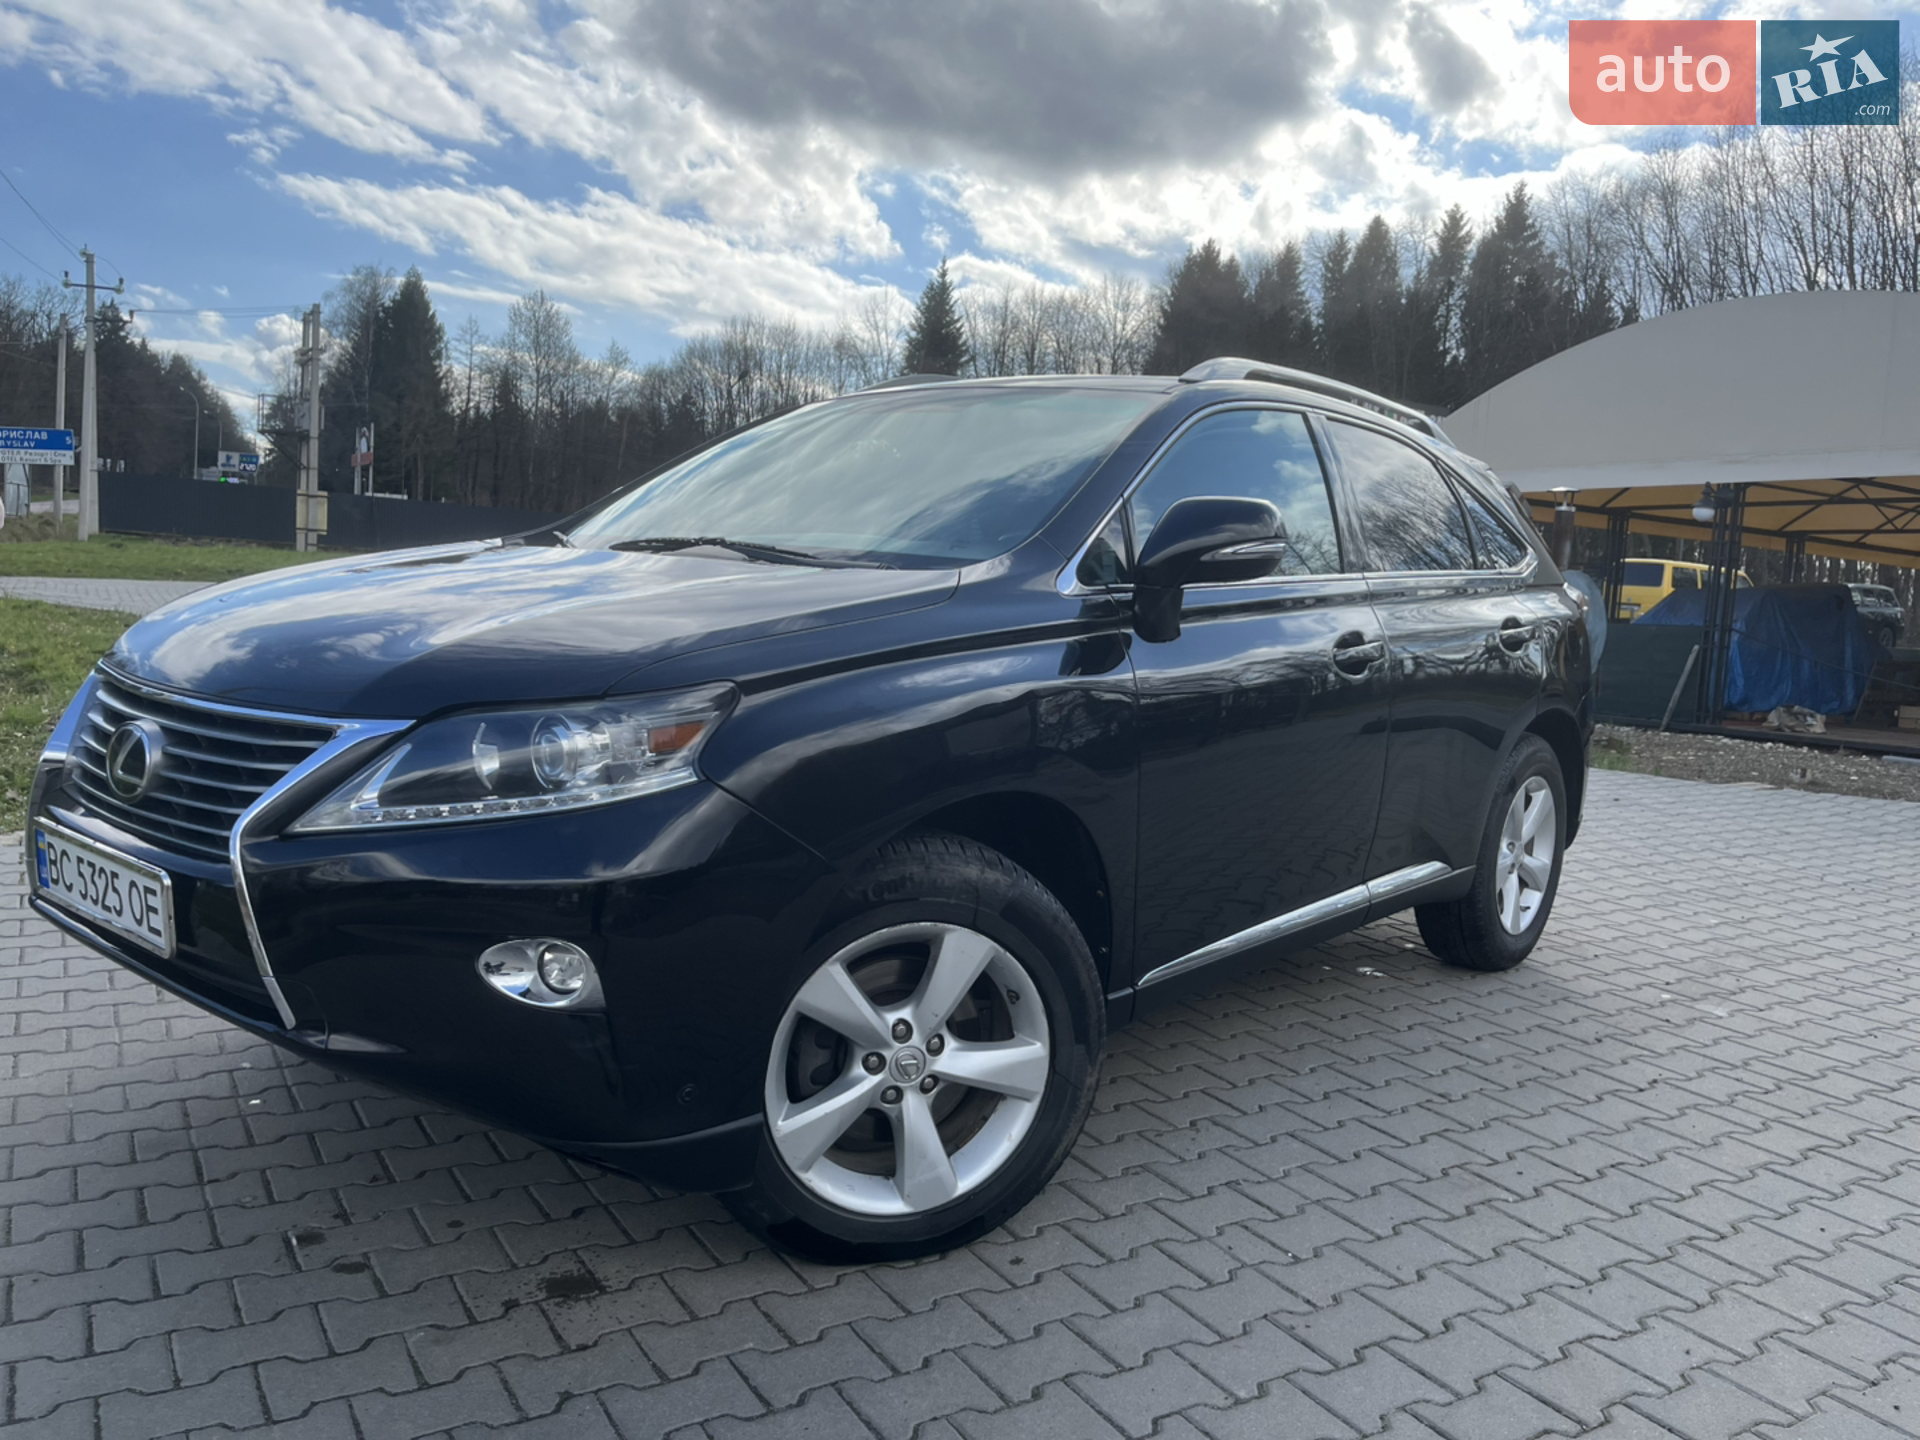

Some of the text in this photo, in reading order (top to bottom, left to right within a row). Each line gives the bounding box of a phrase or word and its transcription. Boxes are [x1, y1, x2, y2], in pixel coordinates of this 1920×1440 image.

[47, 841, 162, 938] BC 5325 OE
